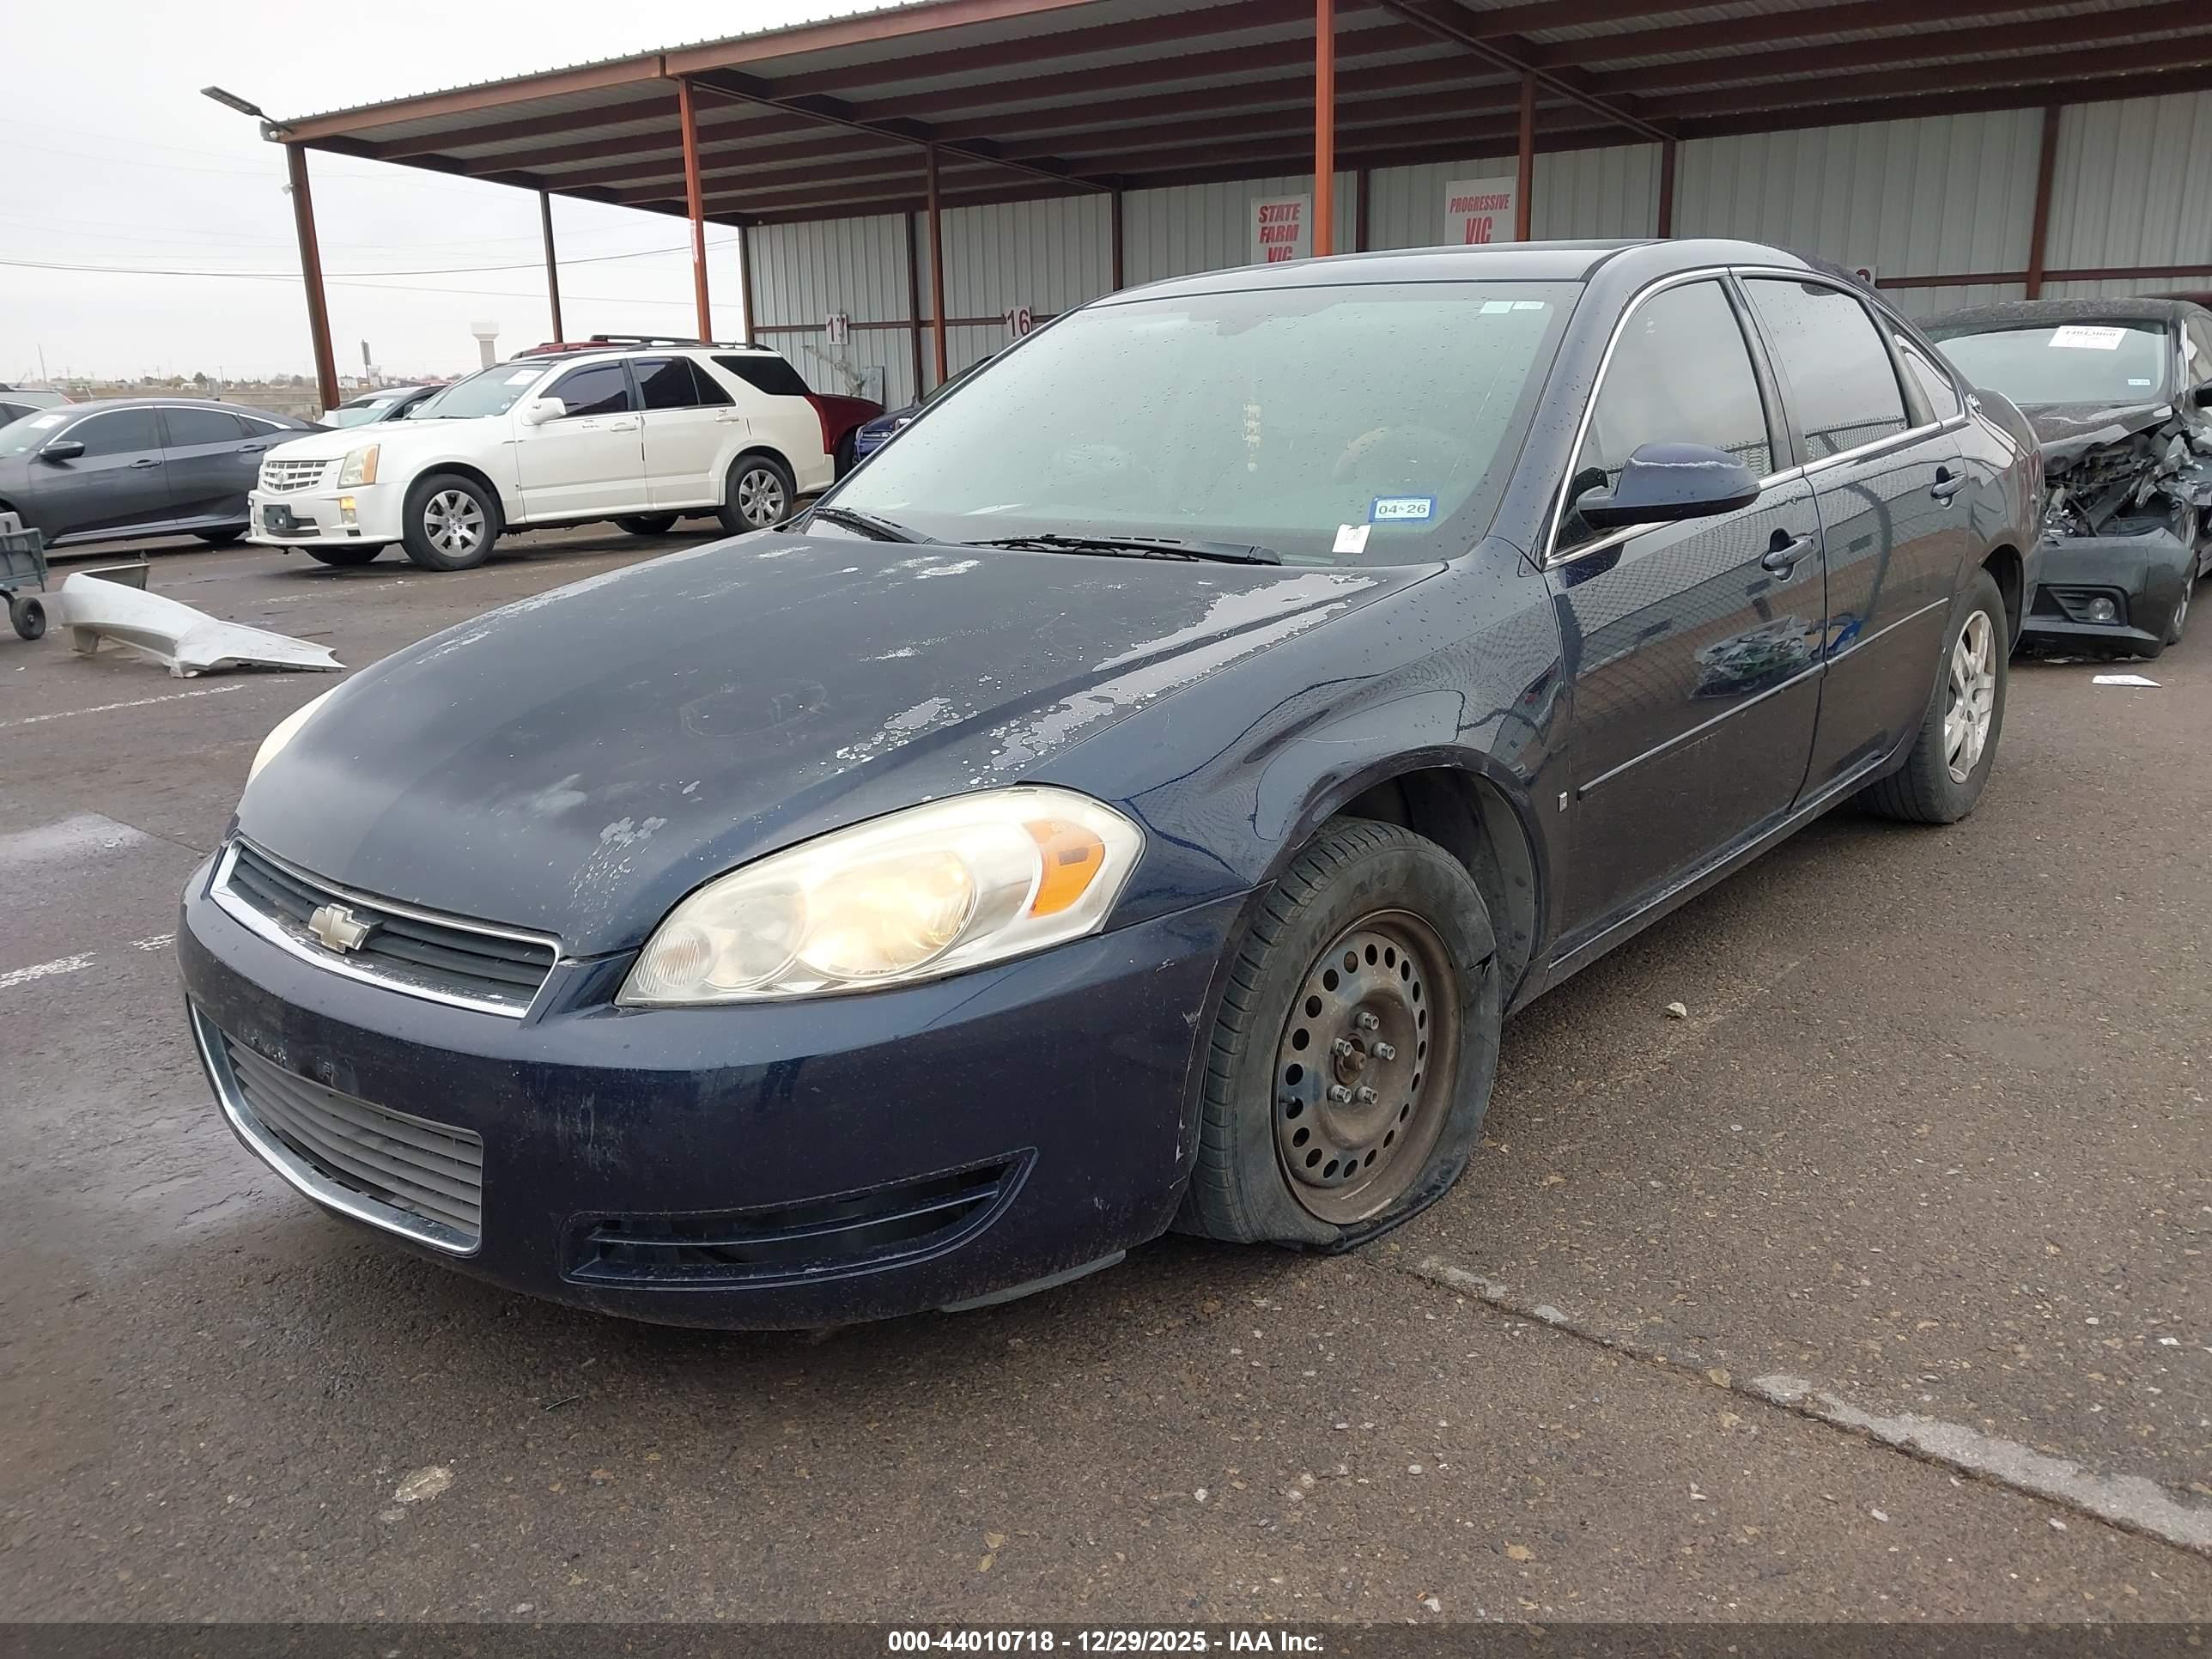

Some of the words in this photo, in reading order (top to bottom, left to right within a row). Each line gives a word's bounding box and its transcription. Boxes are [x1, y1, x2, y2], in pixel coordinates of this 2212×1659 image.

[1258, 203, 1302, 223] STATE
[1449, 193, 1510, 214] PROGRESSIVE
[1259, 224, 1300, 244] FARM
[1465, 216, 1493, 245] VIC
[1268, 246, 1293, 263] VIC
[827, 317, 846, 343] 17
[1007, 309, 1030, 337] 16
